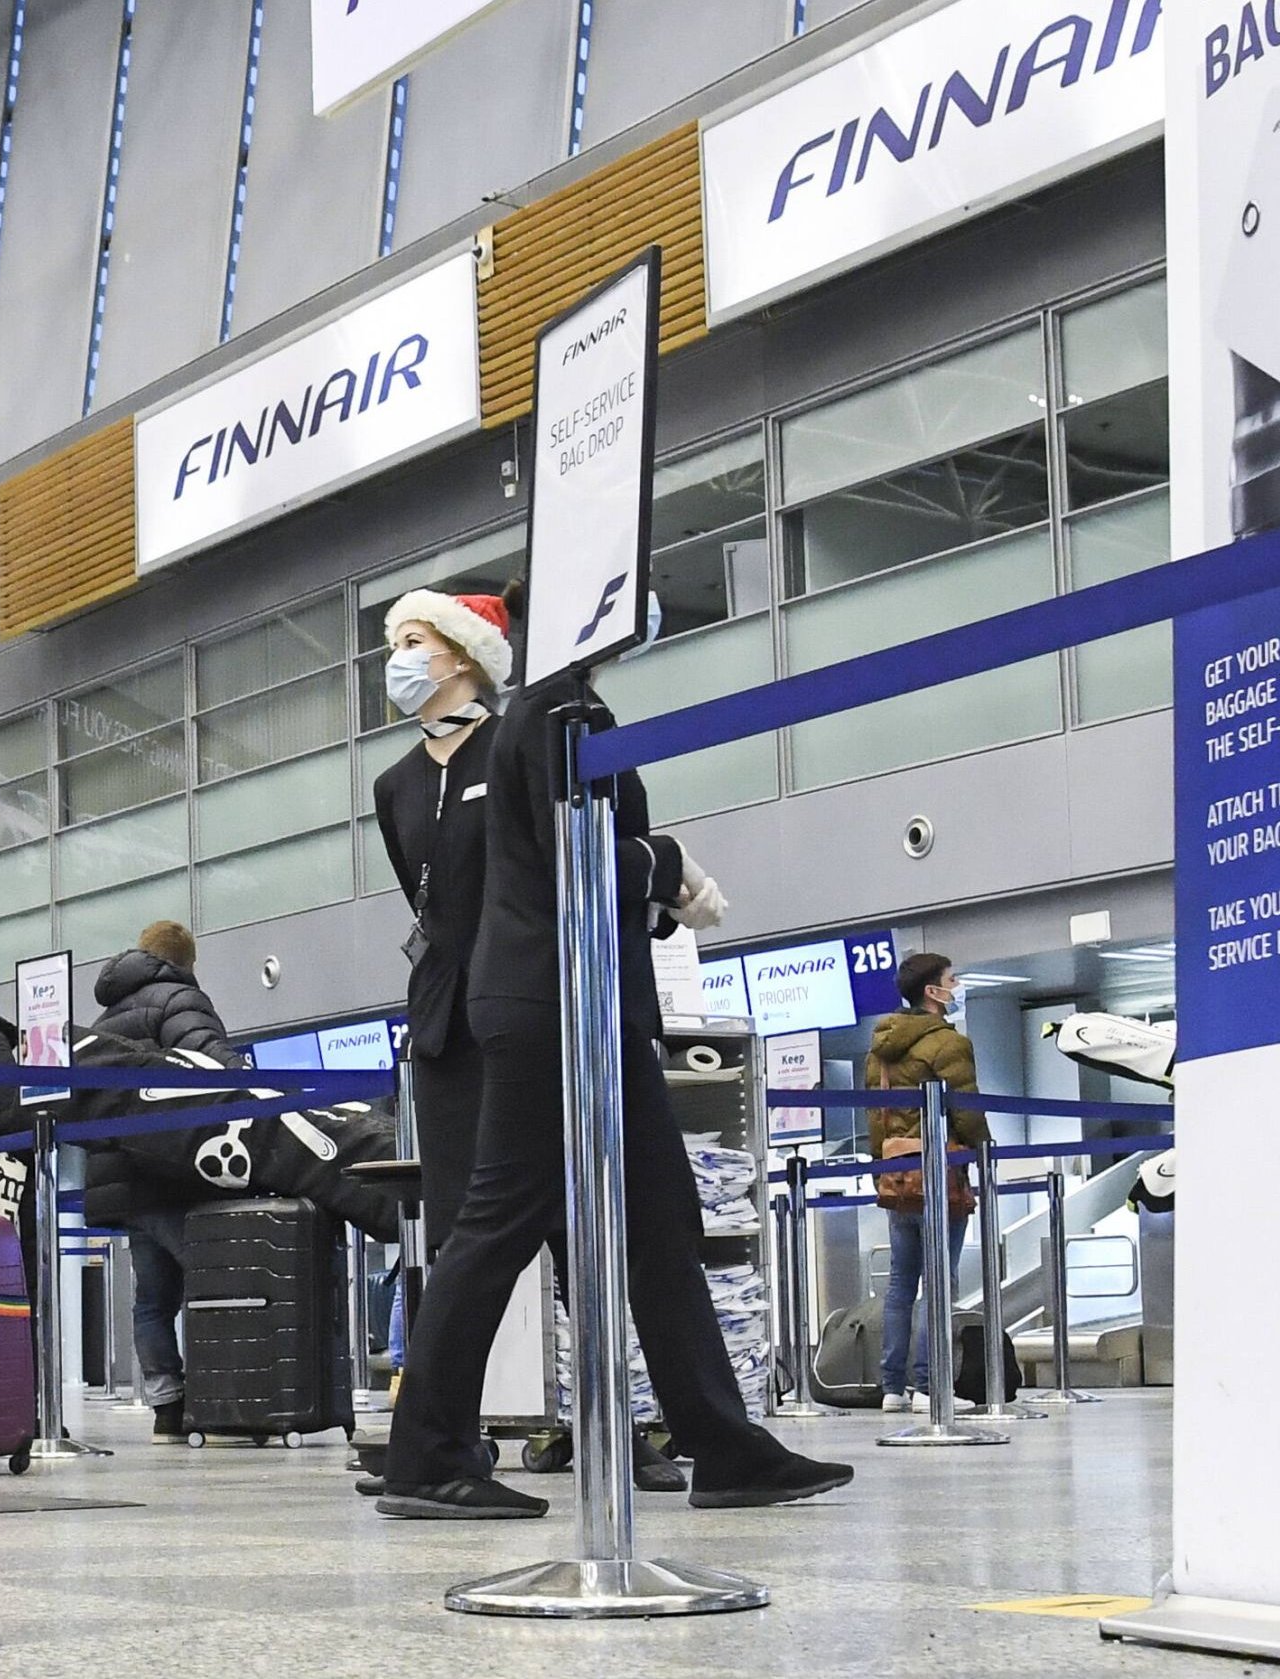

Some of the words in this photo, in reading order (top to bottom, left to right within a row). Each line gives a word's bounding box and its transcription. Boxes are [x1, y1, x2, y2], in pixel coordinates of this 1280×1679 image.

[562, 308, 627, 366] FINNAIR
[173, 334, 428, 501] FINNAIR
[550, 372, 635, 448] SELF-SERVICE
[560, 440, 584, 476] BAG
[589, 416, 624, 459] DROP
[1205, 656, 1232, 688] GET
[1236, 638, 1280, 674] YOUR
[1206, 678, 1277, 726] BAGGAGE
[1206, 732, 1235, 763] THE
[1207, 789, 1263, 828] ATTACH
[1207, 832, 1249, 866] YOUR
[1208, 900, 1246, 931] TAKE
[757, 956, 836, 981] FINNAIR
[852, 941, 893, 973] 215
[1209, 932, 1272, 971] SERVICE
[759, 986, 809, 1006] PRIORITY
[328, 1032, 381, 1051] FINNAIR
[782, 1054, 805, 1065] Keep
